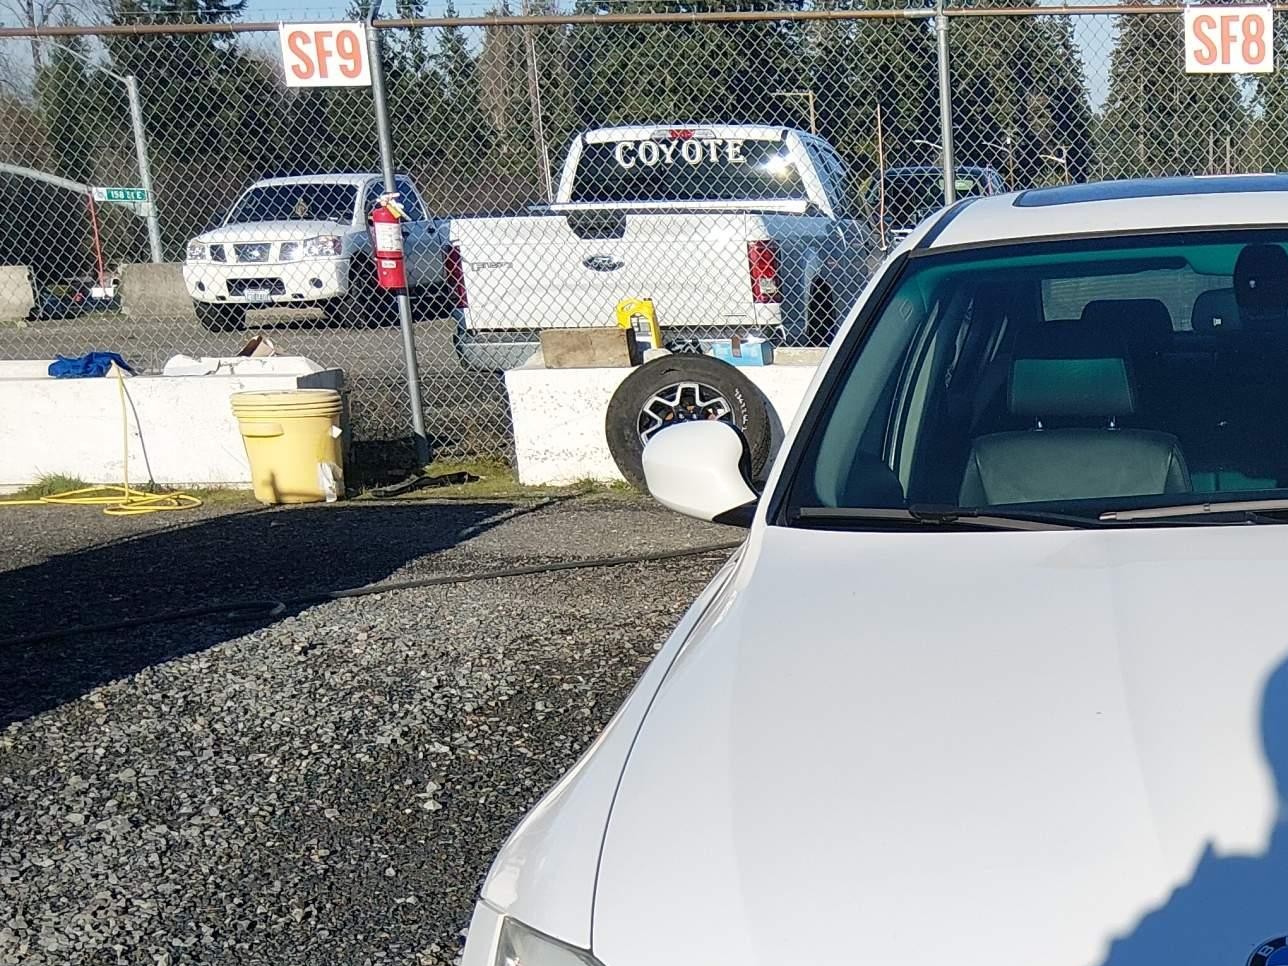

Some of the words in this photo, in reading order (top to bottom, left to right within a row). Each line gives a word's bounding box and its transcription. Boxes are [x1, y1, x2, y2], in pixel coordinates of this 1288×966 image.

[287, 29, 363, 79] SF9
[1192, 14, 1266, 65] SF8
[615, 140, 747, 168] COYOTE
